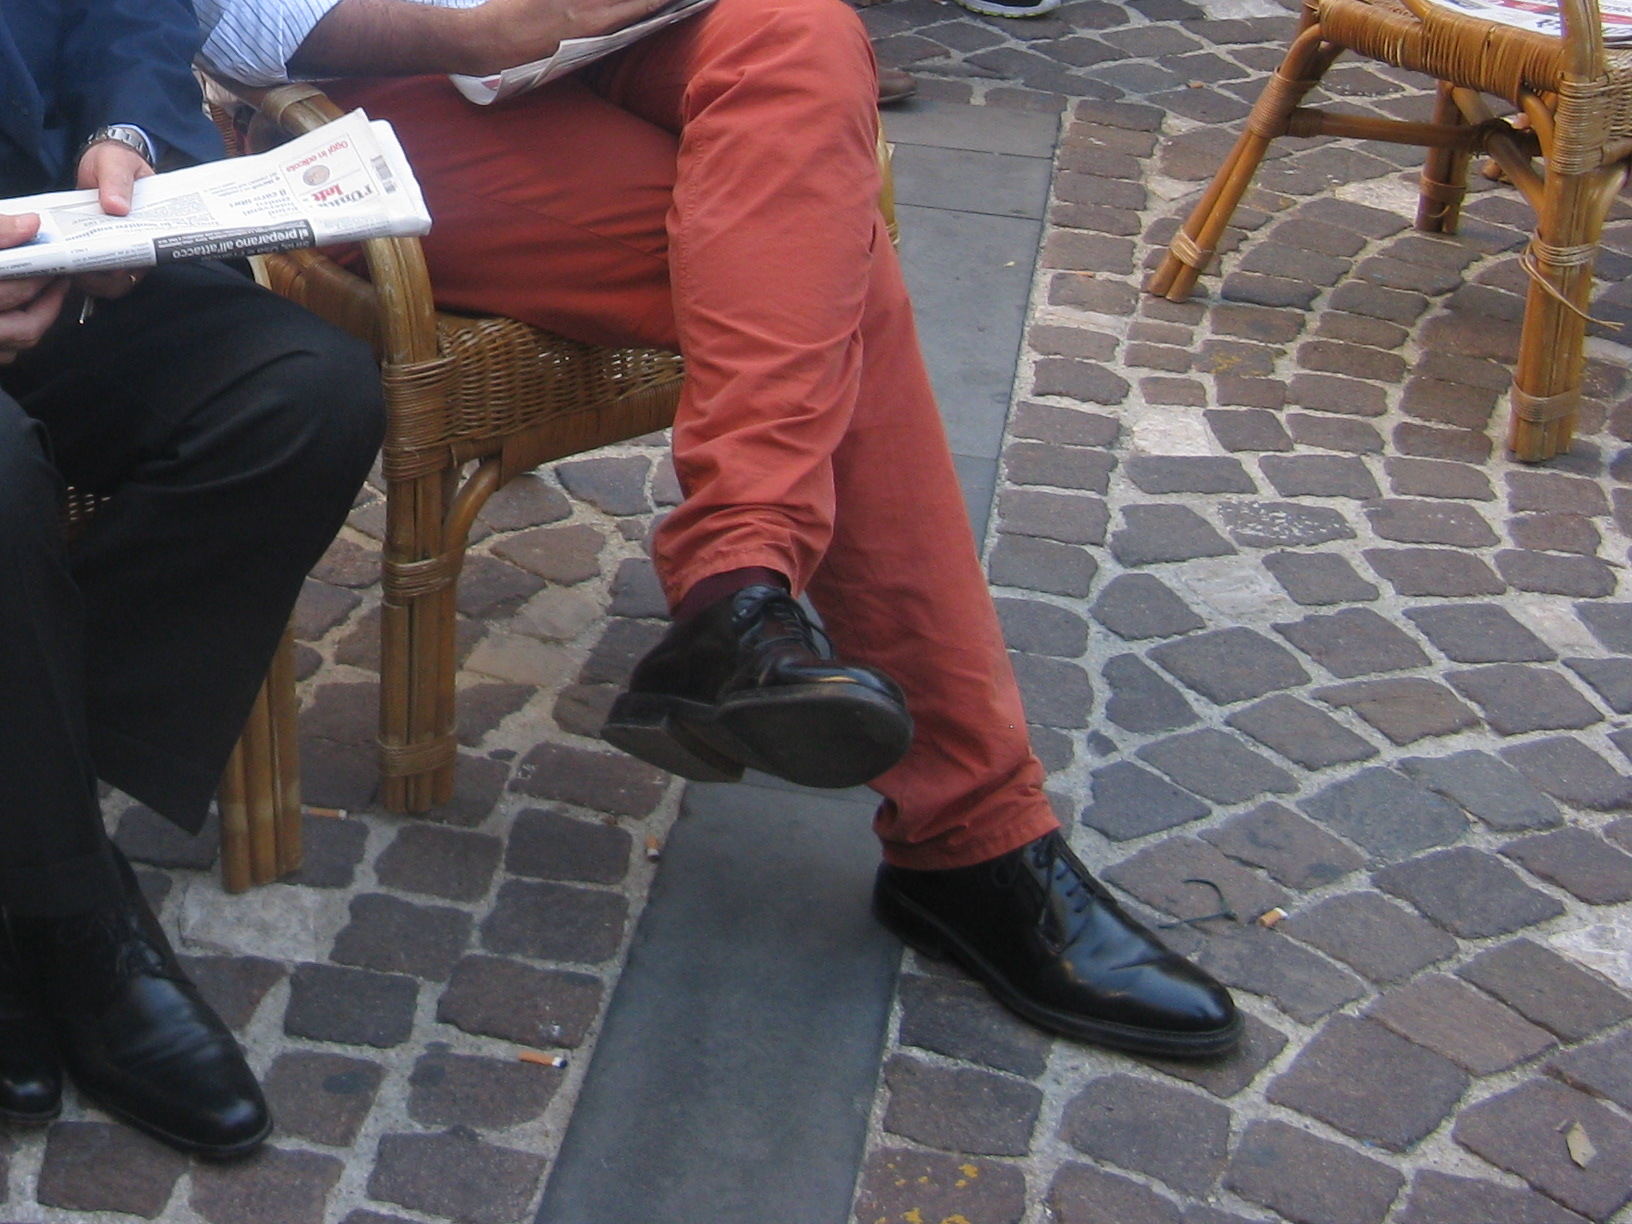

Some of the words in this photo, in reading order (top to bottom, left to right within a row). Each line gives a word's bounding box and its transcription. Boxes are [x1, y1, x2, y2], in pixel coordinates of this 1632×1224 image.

[327, 140, 349, 155] Oggi
[235, 230, 298, 248] preparano
[172, 241, 235, 259] all'attacco
